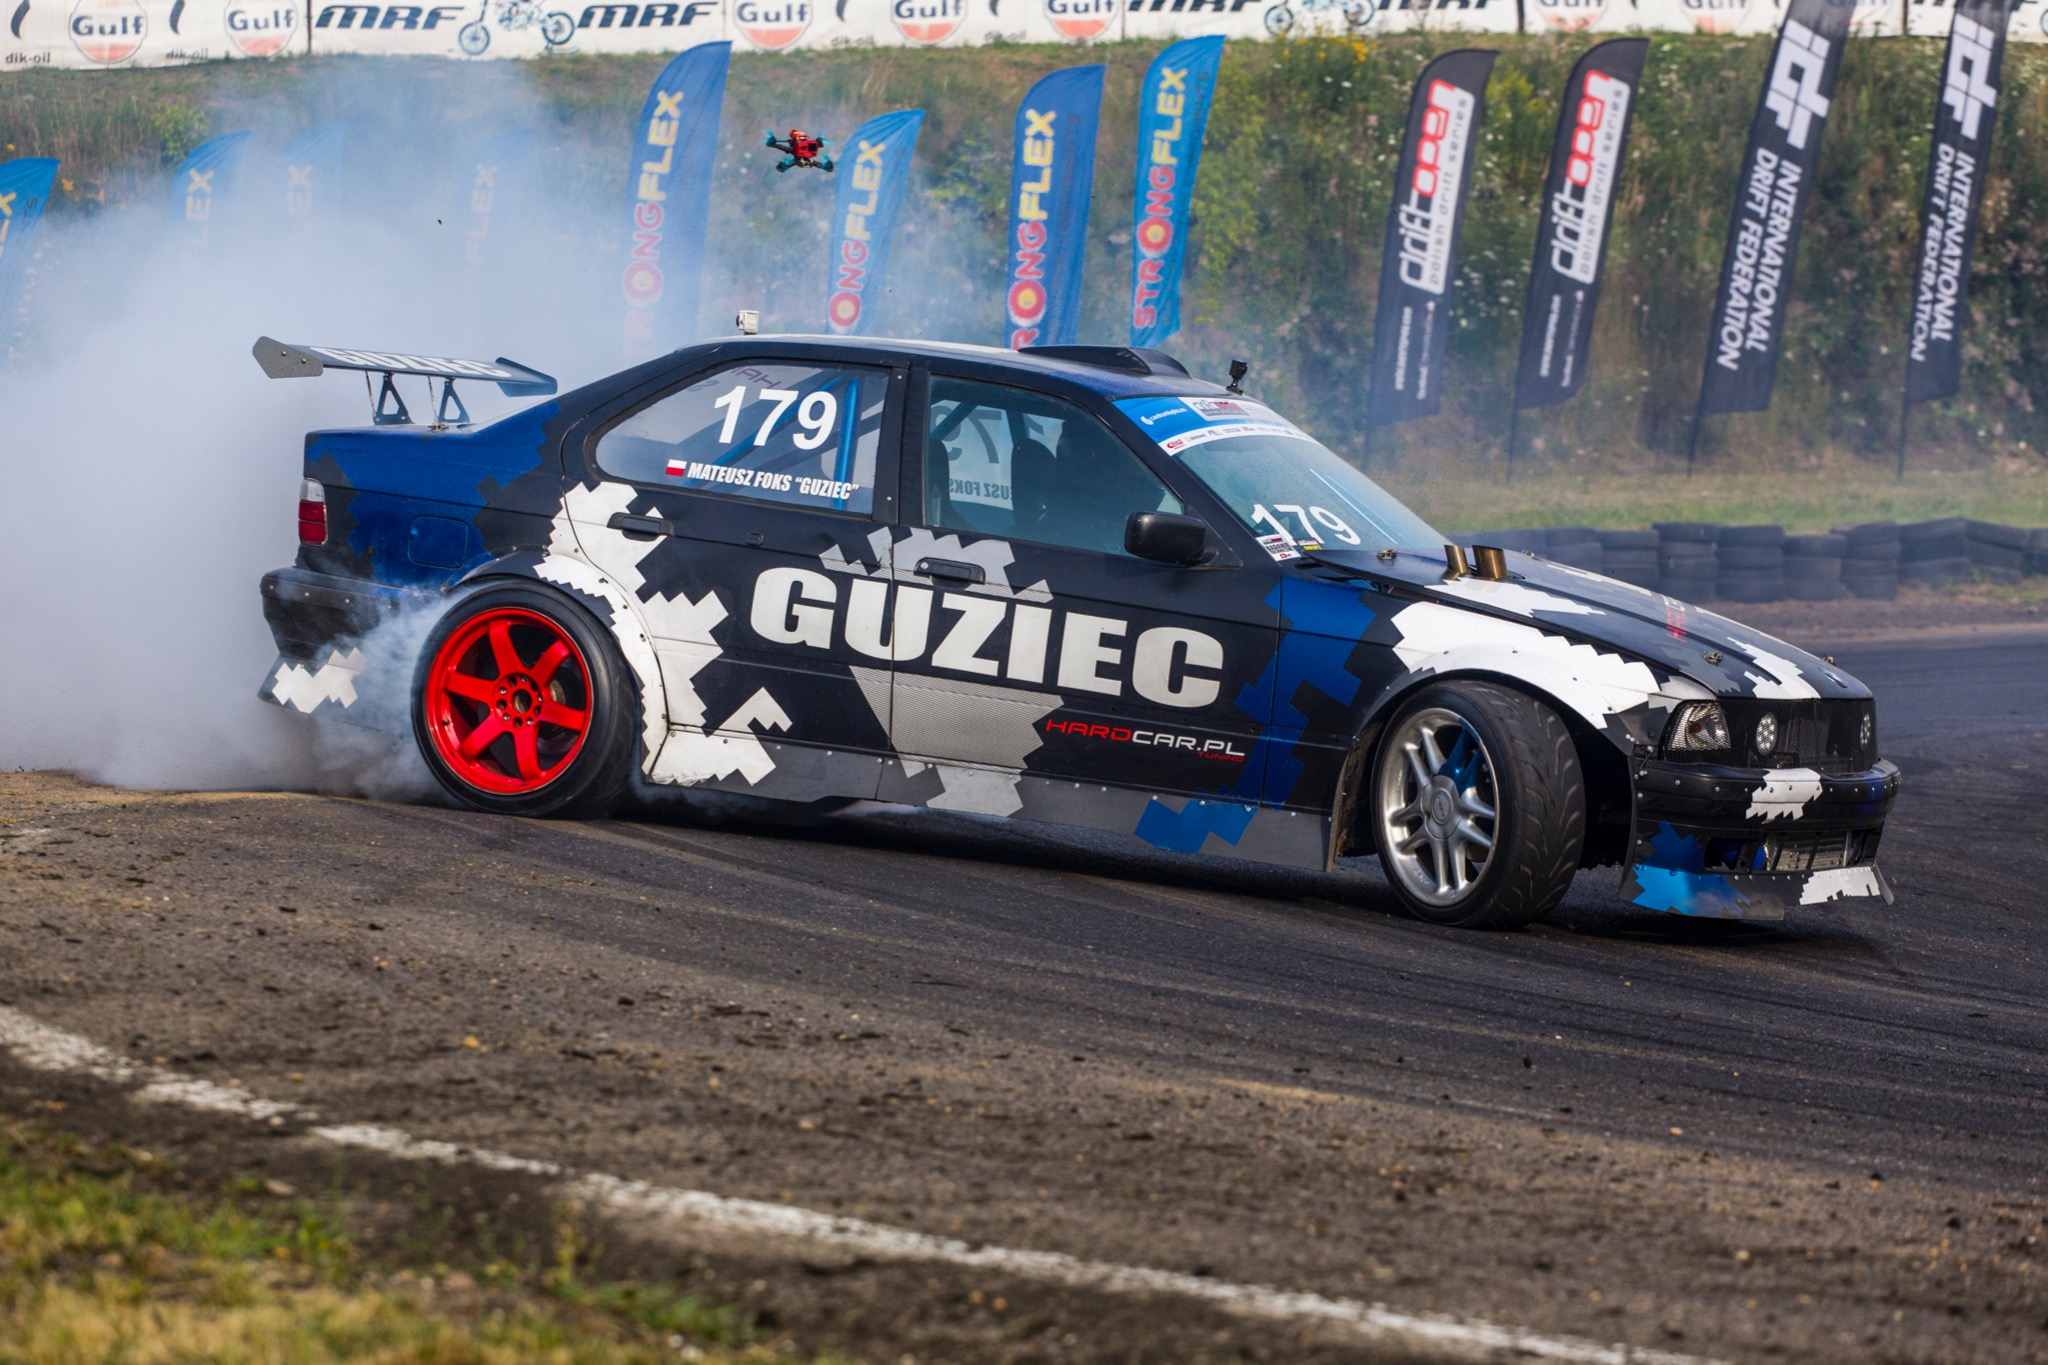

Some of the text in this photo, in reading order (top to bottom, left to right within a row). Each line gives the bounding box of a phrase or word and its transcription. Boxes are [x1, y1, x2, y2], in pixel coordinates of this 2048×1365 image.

[72, 15, 144, 36] Gulf
[228, 9, 295, 31] Gulf
[316, 5, 464, 29] MRF
[577, 2, 719, 28] MRF
[737, 2, 807, 22] Gulf
[895, 0, 961, 18] Gulf
[5, 52, 51, 64] dik-oil
[1133, 66, 1188, 330] STRONGFLEX
[1716, 146, 1779, 371] DRIFT FEDERATION
[1745, 159, 1803, 353] INTERNATIONAL
[1910, 142, 1955, 363] DRIFT FEDERATION
[1931, 150, 1977, 342] INTERNATIONAL
[714, 385, 837, 450] 179
[687, 461, 754, 486] MATEUSZ
[754, 471, 793, 491] FOKS
[1251, 503, 1362, 546] 179
[749, 566, 1225, 709] GUZIEC
[1045, 718, 1246, 757] HARDCAR.PL
[1197, 751, 1245, 764] TUNING
